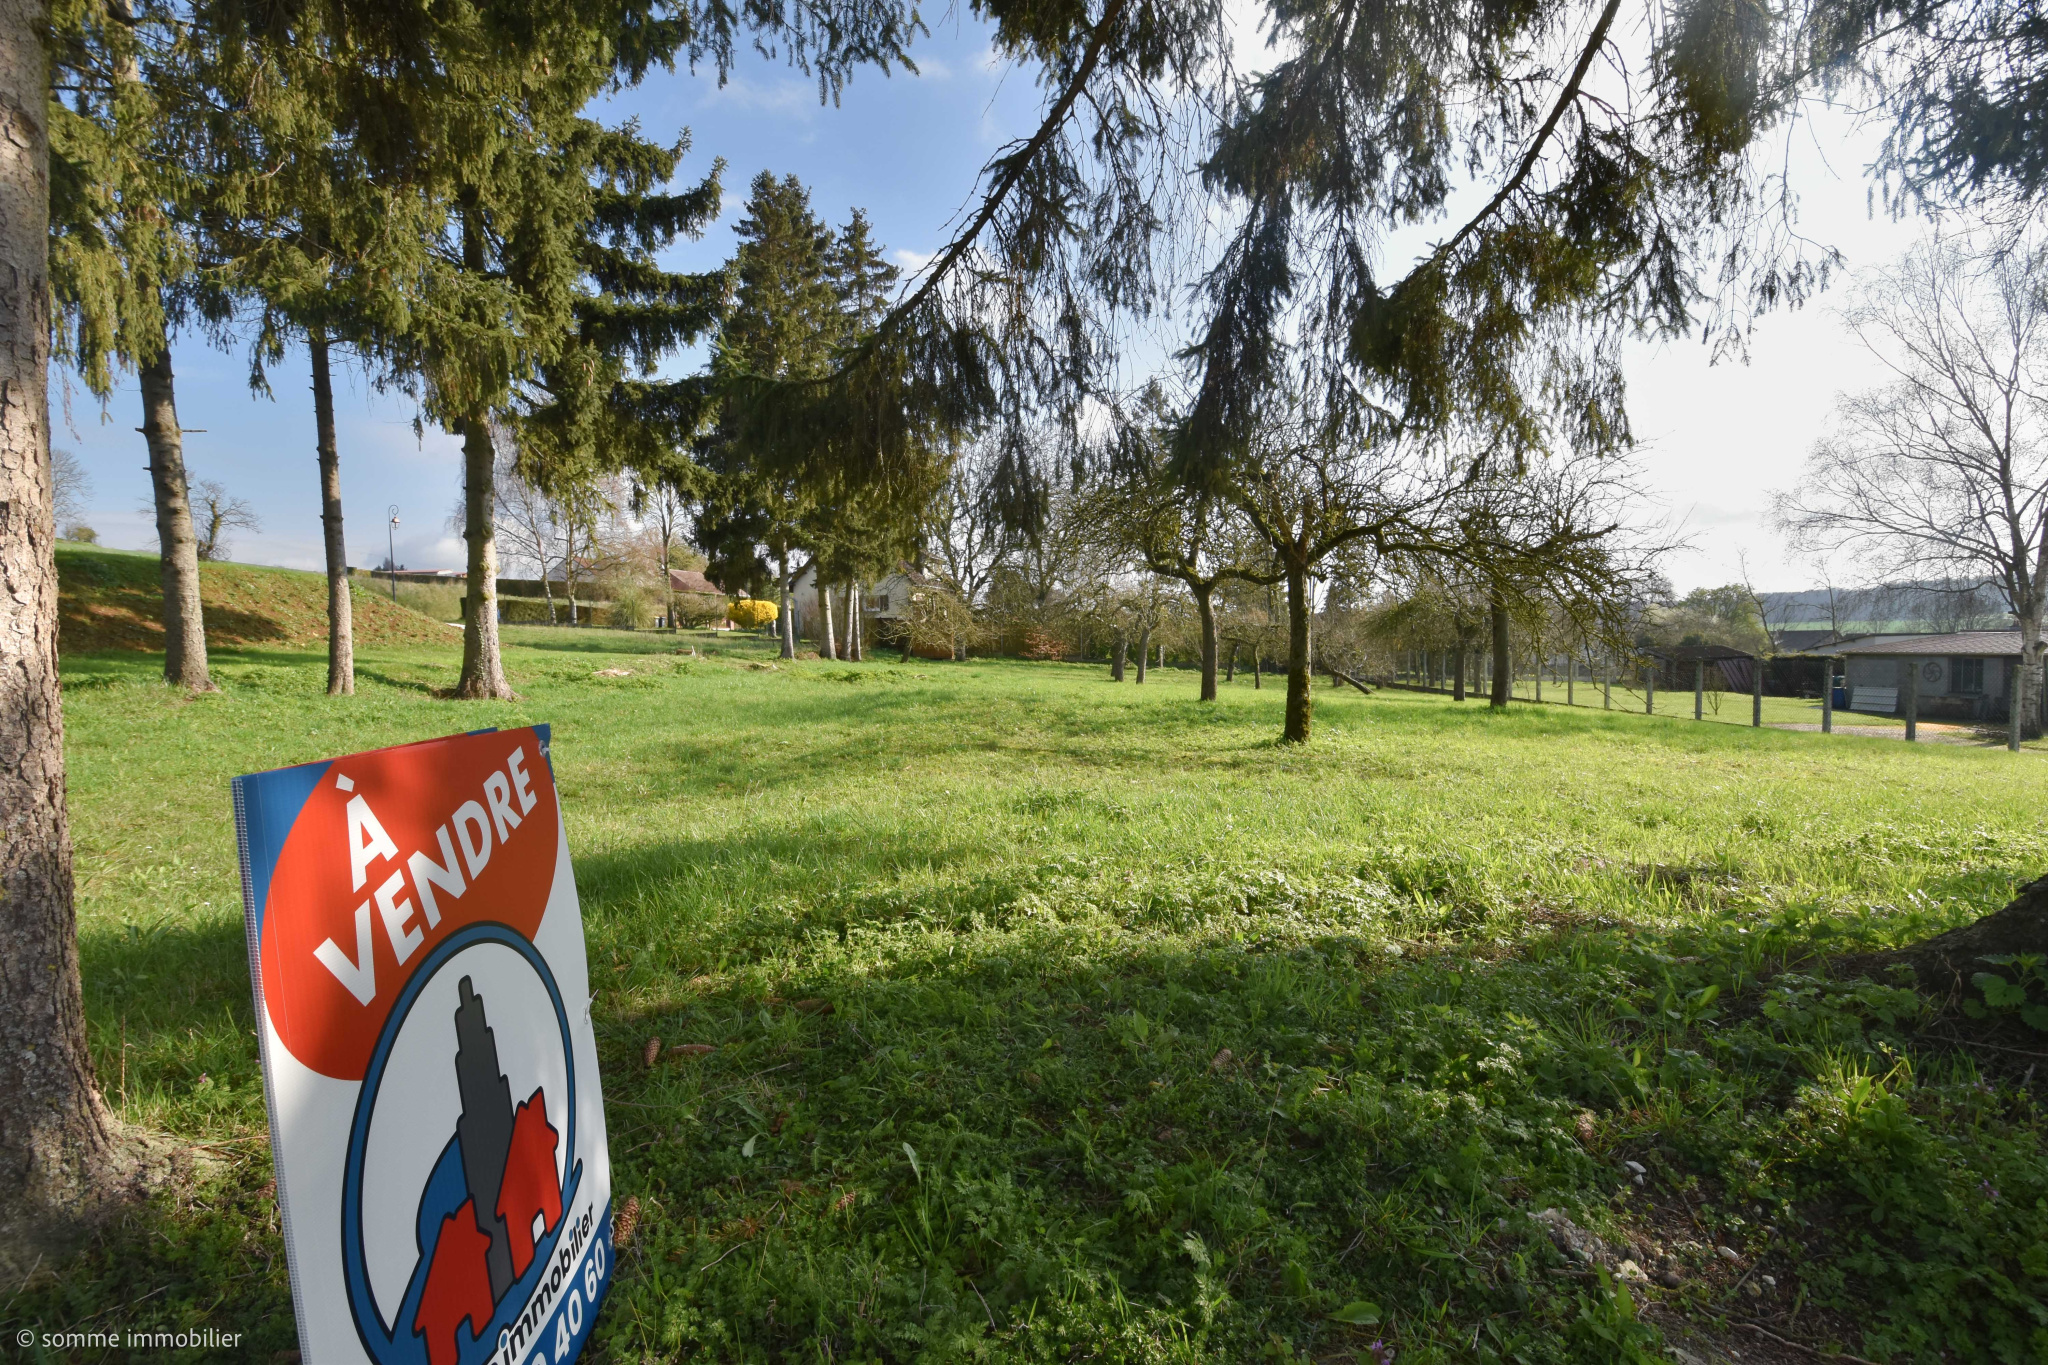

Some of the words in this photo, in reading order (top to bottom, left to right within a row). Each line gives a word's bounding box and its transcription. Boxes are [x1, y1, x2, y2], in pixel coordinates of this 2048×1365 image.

[313, 745, 538, 1007] VENDRE
[335, 772, 399, 894] À
[500, 1201, 595, 1365] immobilier
[554, 1288, 583, 1364] 40
[584, 1237, 606, 1303] 60
